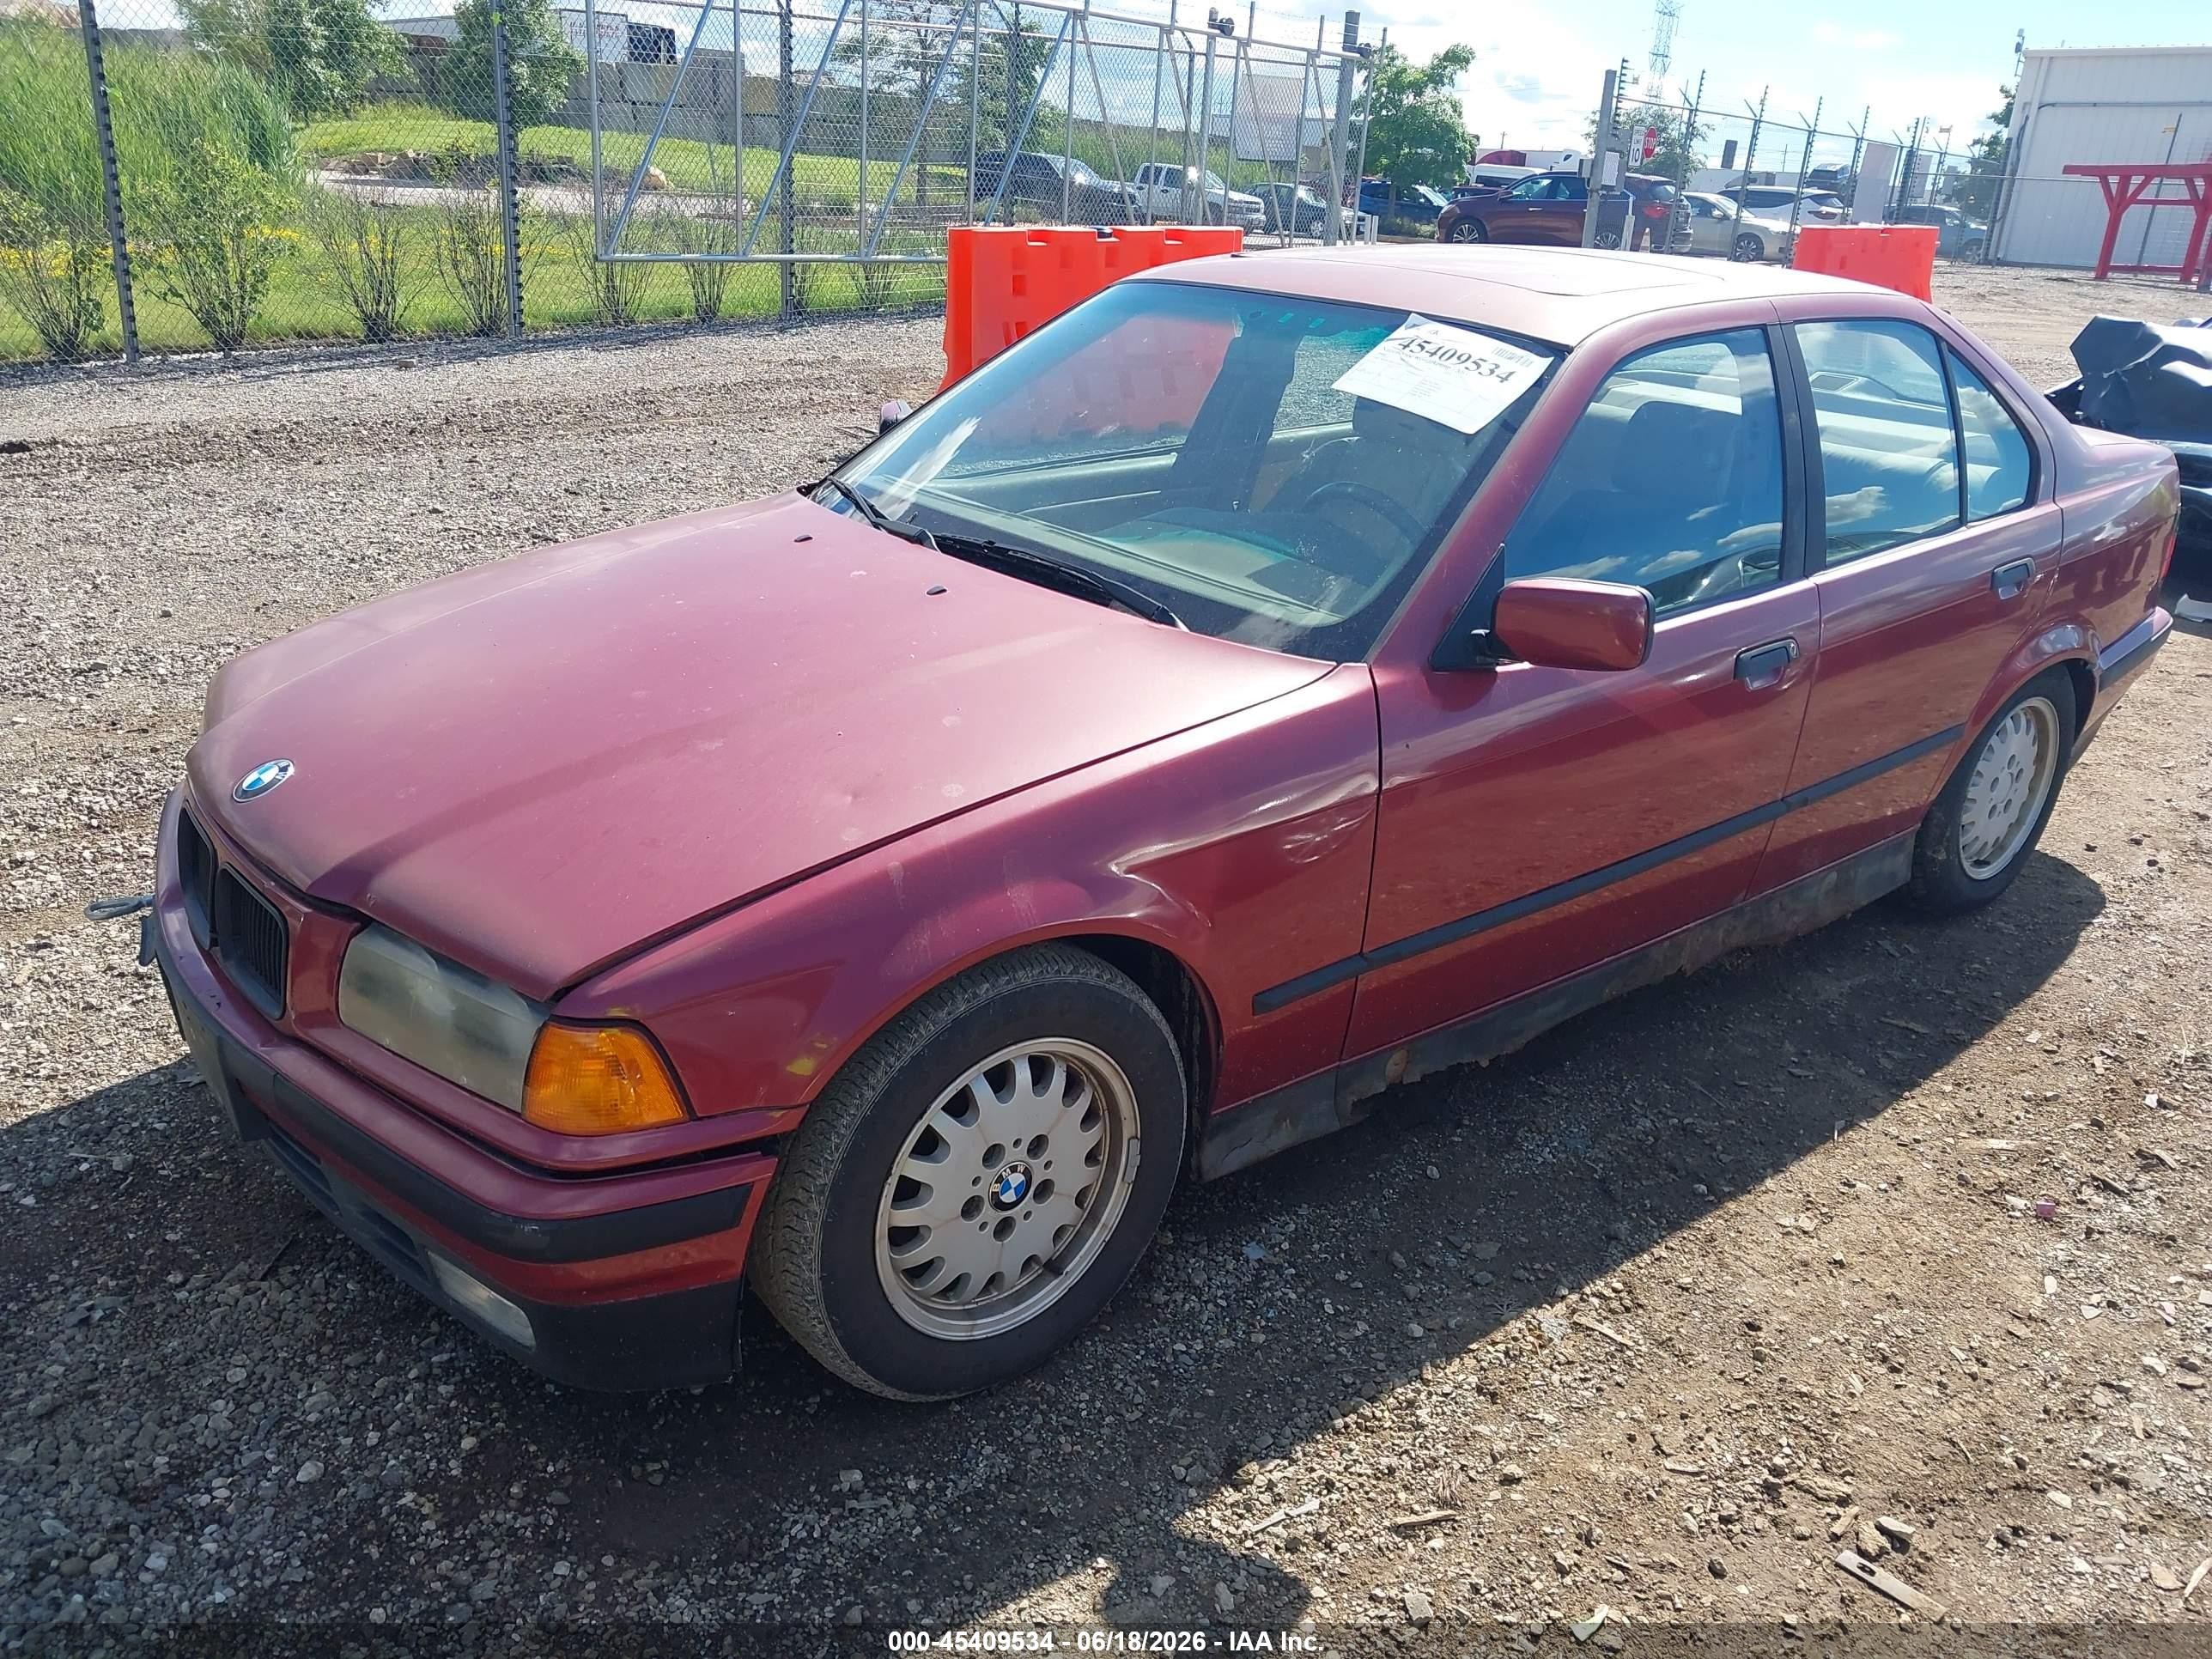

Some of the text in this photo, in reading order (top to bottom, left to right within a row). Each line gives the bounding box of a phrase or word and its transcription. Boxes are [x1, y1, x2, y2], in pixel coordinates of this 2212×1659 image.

[1644, 137, 1657, 149] STOP
[1631, 147, 1640, 162] 10
[1398, 335, 1517, 384] 45409534
[992, 1164, 1025, 1192] BMW
